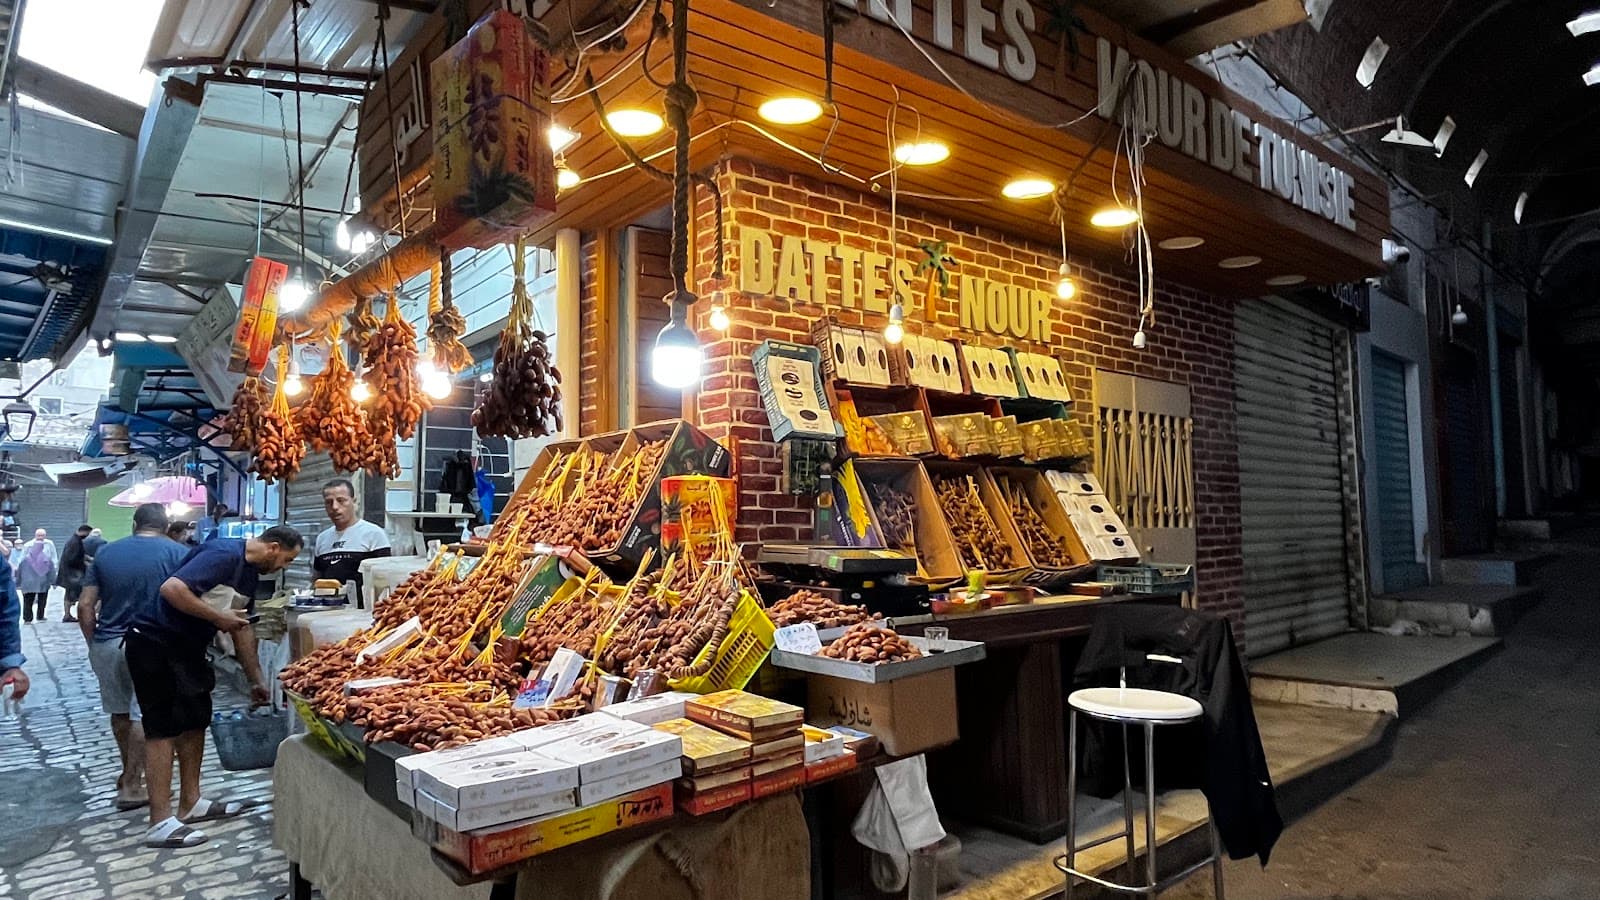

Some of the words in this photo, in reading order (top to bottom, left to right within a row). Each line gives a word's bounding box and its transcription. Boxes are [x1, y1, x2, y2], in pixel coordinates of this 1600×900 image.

[1211, 98, 1253, 180] DE
[1253, 122, 1356, 232] TUNISIE
[739, 225, 914, 318] DATTES
[959, 273, 1051, 343] NOUR
